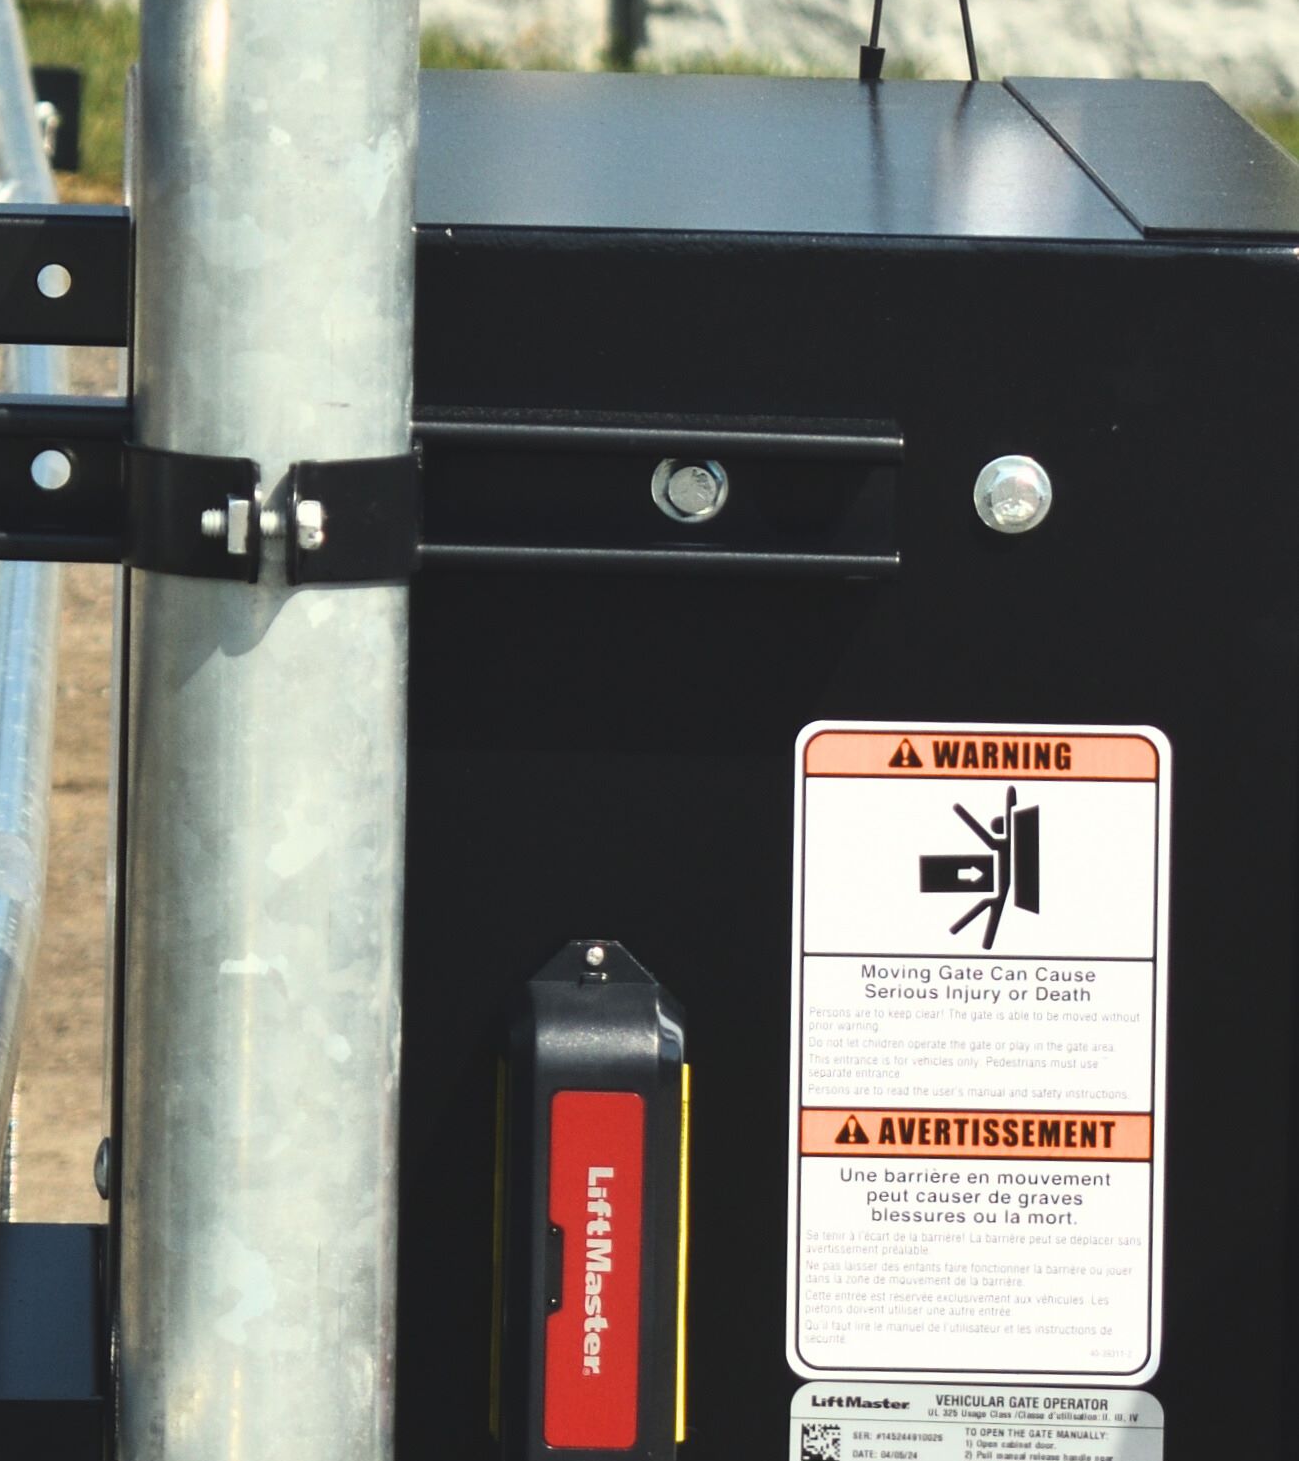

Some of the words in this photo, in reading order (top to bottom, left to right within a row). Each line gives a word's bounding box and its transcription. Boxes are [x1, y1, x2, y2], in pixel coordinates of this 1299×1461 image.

[932, 740, 1072, 770] WARNING
[861, 963, 931, 983] Moving
[938, 964, 983, 980] Gate
[990, 965, 1027, 981] Can
[1034, 966, 1096, 983] Cause
[864, 983, 938, 999] Serious
[946, 984, 1001, 1004] Injury
[1008, 988, 1028, 1001] or
[1035, 986, 1090, 1002] Death
[808, 1006, 851, 1018] Persons
[854, 1009, 871, 1018] are
[873, 1008, 884, 1019] to
[888, 1008, 912, 1020] keep
[948, 1008, 967, 1020] The
[970, 1009, 993, 1021] gate
[995, 1011, 1005, 1020] is
[1007, 1009, 1029, 1021] able
[1032, 1011, 1043, 1021] to
[1046, 1011, 1059, 1022] be
[1061, 1011, 1097, 1022] moved
[1100, 1011, 1140, 1023] without
[808, 1019, 833, 1033] prior
[808, 1035, 823, 1048] Do
[825, 1037, 843, 1048] not
[846, 1037, 859, 1048] let
[861, 1037, 904, 1049] children
[907, 1038, 947, 1050] operate
[949, 1039, 966, 1050] the
[969, 1039, 992, 1052] gate
[994, 1041, 1006, 1051] or
[1008, 1039, 1030, 1052] play
[1033, 1042, 1043, 1051] in
[1046, 1041, 1063, 1051] the
[1065, 1041, 1089, 1053] gate
[808, 1052, 830, 1064] This
[832, 1054, 878, 1066] entrance
[881, 1056, 890, 1065] is
[893, 1054, 908, 1066] for
[911, 1055, 954, 1067] vehicles
[985, 1055, 1049, 1068] Pedestrians
[1049, 1058, 1076, 1068] must
[1079, 1059, 1099, 1069] use
[808, 1067, 852, 1079] separate
[807, 1083, 850, 1095] Persons
[852, 1086, 870, 1096] are
[872, 1085, 883, 1096] to
[886, 1085, 909, 1096] read
[912, 1085, 929, 1096] the
[932, 1085, 964, 1097] user's
[966, 1086, 1005, 1098] manual
[1008, 1087, 1028, 1098] and
[1030, 1087, 1062, 1100] safety
[877, 1115, 1116, 1149] AVERTISSEMENT
[840, 1167, 877, 1182] Une
[884, 1167, 960, 1184] barrière
[966, 1172, 989, 1184] en
[997, 1171, 1110, 1186] mouvement
[866, 1188, 908, 1206] peut
[915, 1191, 981, 1204] causer
[987, 1189, 1011, 1204] de
[1017, 1192, 1083, 1209] graves
[871, 1207, 966, 1223] blessures
[973, 1211, 996, 1224] ou
[1004, 1209, 1020, 1224] la
[1027, 1210, 1077, 1225] mort.
[582, 1167, 614, 1374] LiftMaster
[811, 1394, 909, 1410] LiftMaster
[935, 1393, 1005, 1408] VEHICULAR
[1008, 1395, 1039, 1409] GATE
[1042, 1396, 1108, 1411] OPERATOR
[852, 1431, 872, 1440] SER:
[964, 1427, 977, 1436] TO
[979, 1427, 1005, 1437] OPEN
[1007, 1427, 1025, 1438] THE
[1028, 1428, 1053, 1439] GATE
[851, 1448, 877, 1459] DATE:
